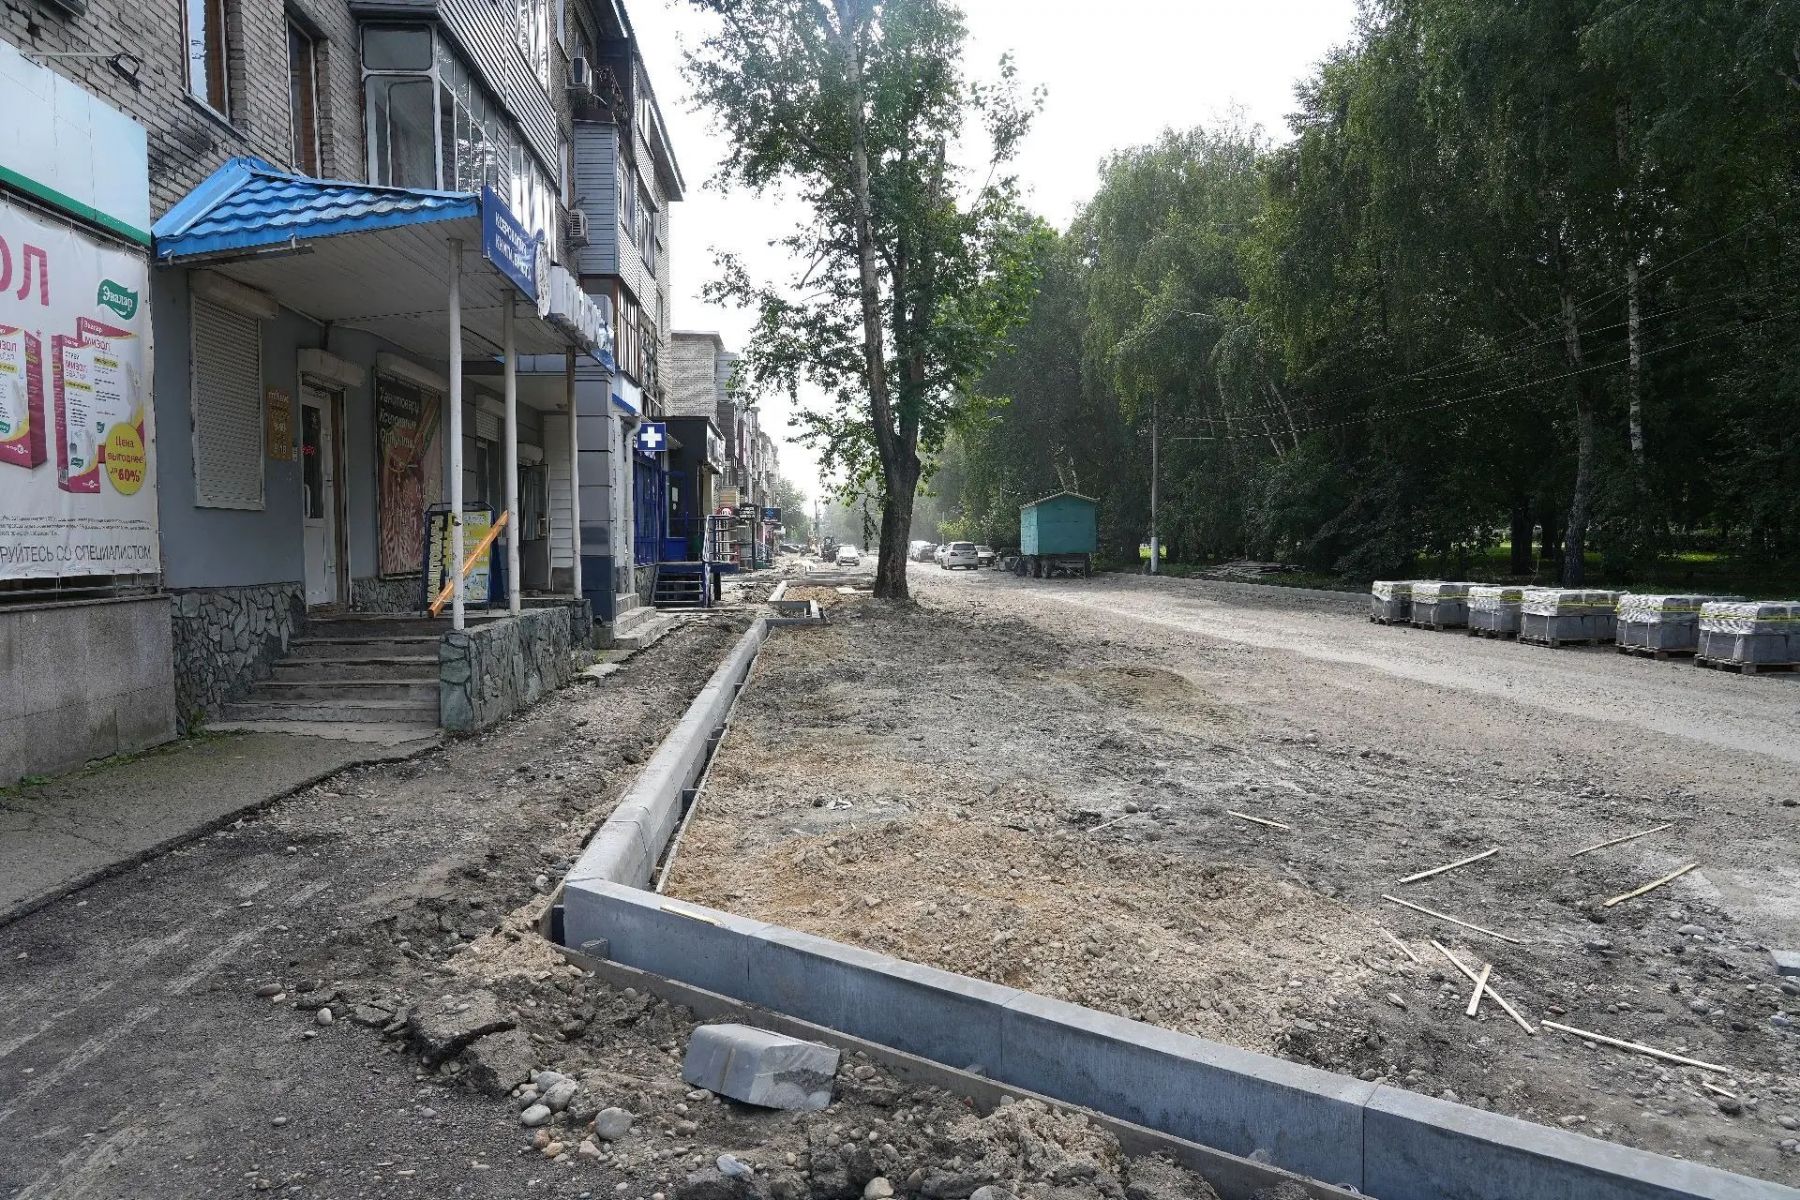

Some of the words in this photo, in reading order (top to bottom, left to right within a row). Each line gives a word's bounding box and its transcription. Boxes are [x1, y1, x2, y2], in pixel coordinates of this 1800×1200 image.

[103, 285, 133, 311] Эвалар
[115, 435, 134, 449] Цена
[56, 545, 72, 562] СО
